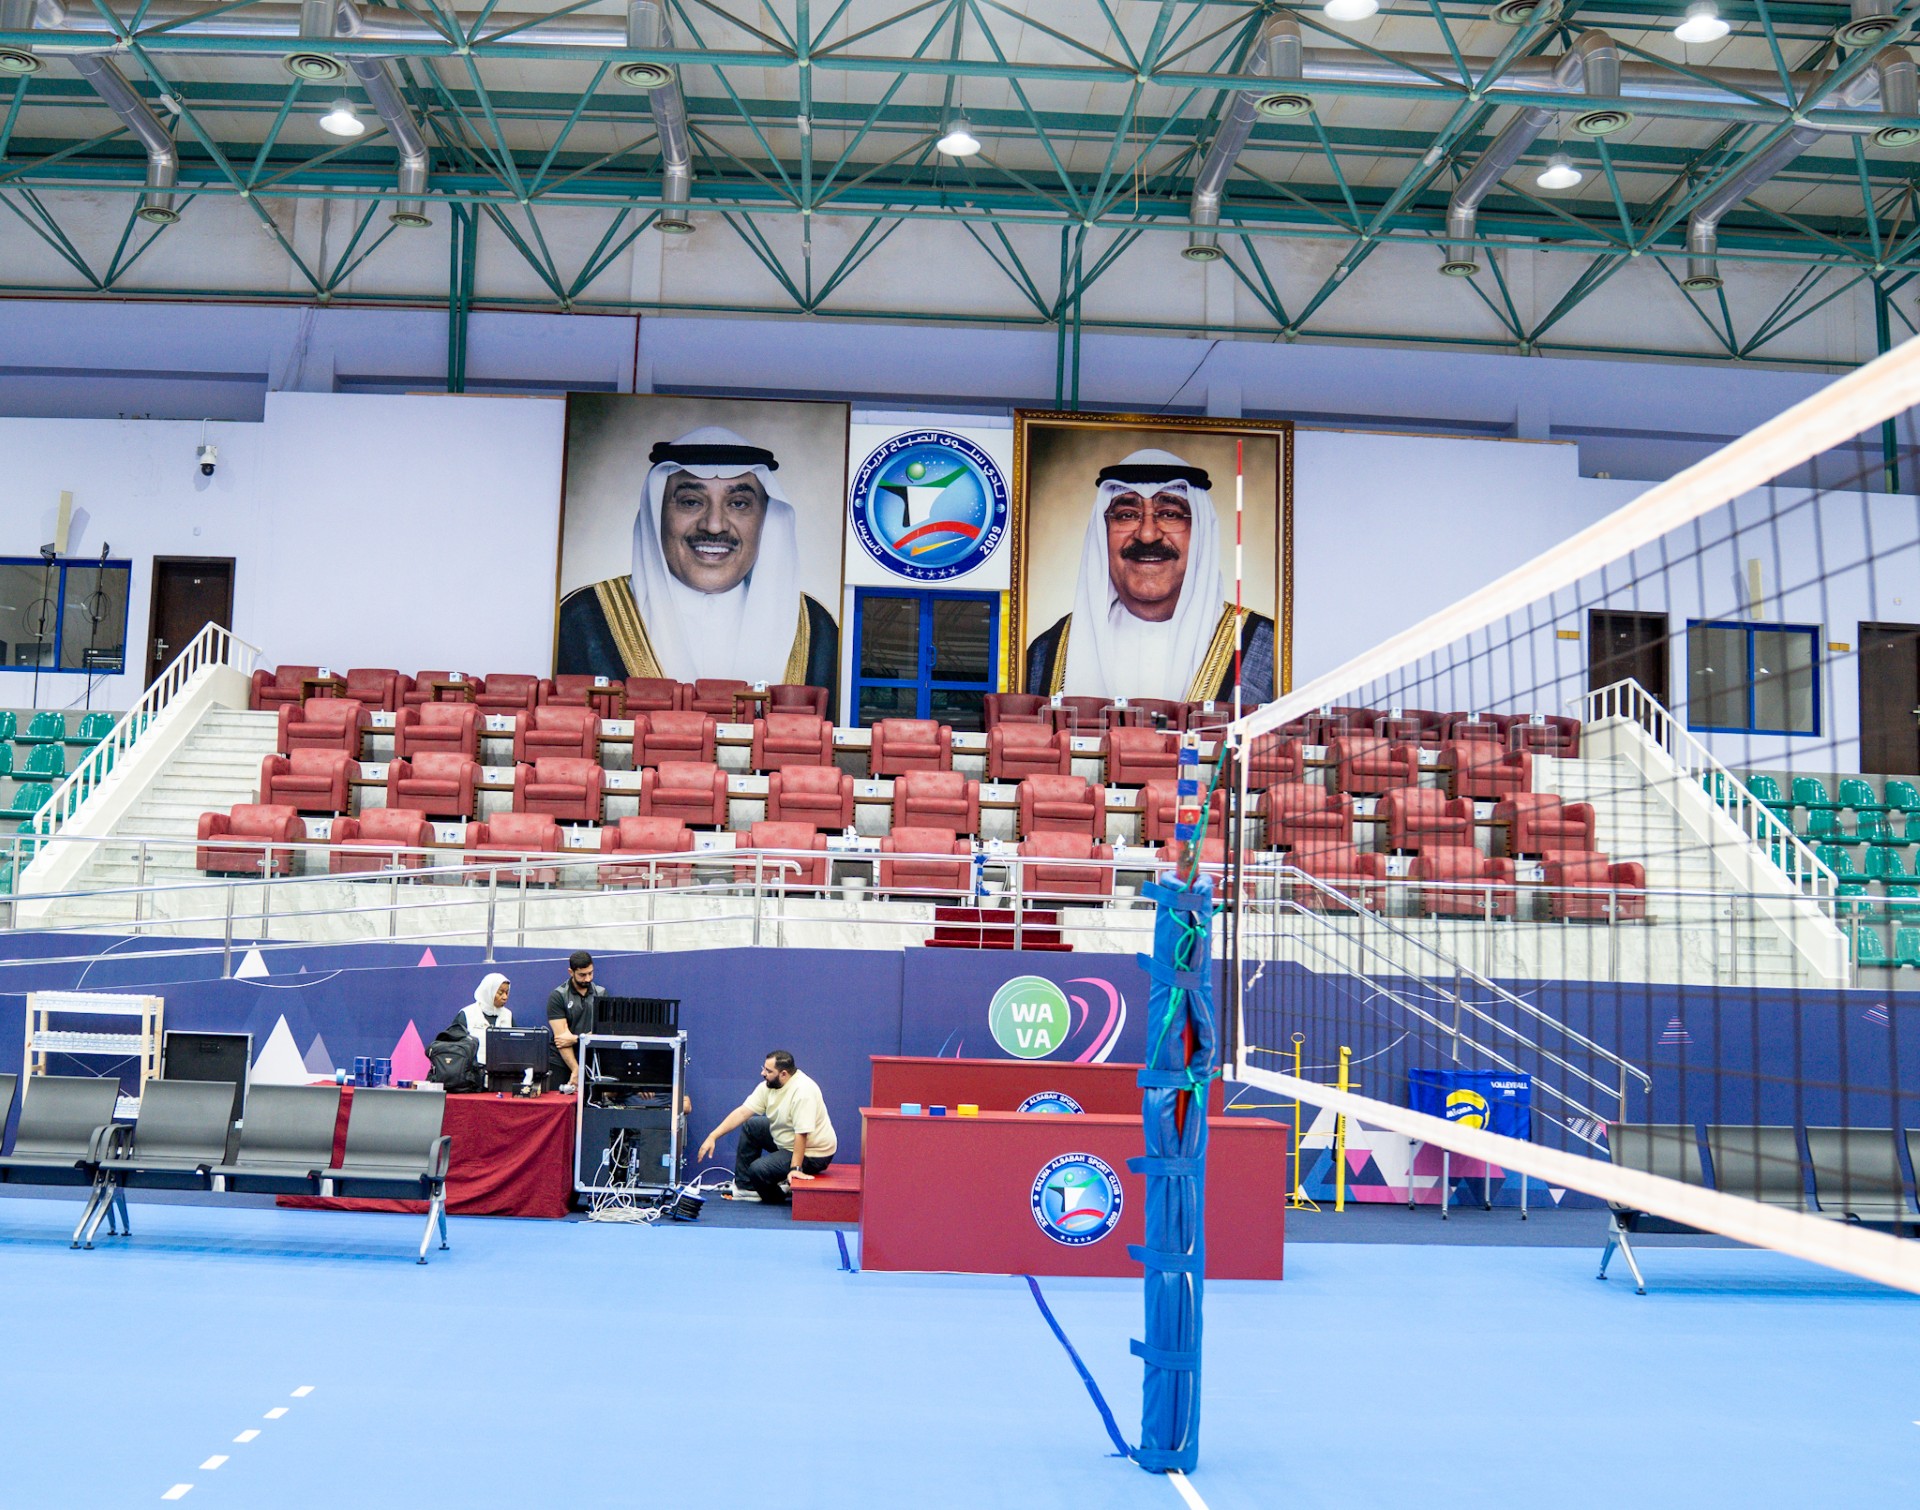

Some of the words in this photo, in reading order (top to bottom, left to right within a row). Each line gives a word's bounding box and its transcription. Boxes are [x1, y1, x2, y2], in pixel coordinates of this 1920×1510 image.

[889, 432, 938, 453] الصباح
[857, 447, 889, 495] الرياضي
[983, 464, 1005, 499] نادي
[979, 526, 1002, 556] 2009
[1011, 1002, 1054, 1024] WA
[1016, 1028, 1052, 1049] VA
[1029, 1093, 1058, 1106] ALSABAH
[1059, 1096, 1079, 1111] SPORT
[1035, 1169, 1052, 1192] SALWA
[1051, 1155, 1086, 1169] ALSABAH
[1087, 1157, 1111, 1175] SPORT
[1108, 1175, 1120, 1196] CLUB
[1034, 1206, 1049, 1228] SINCE
[1105, 1211, 1119, 1228] 2009
